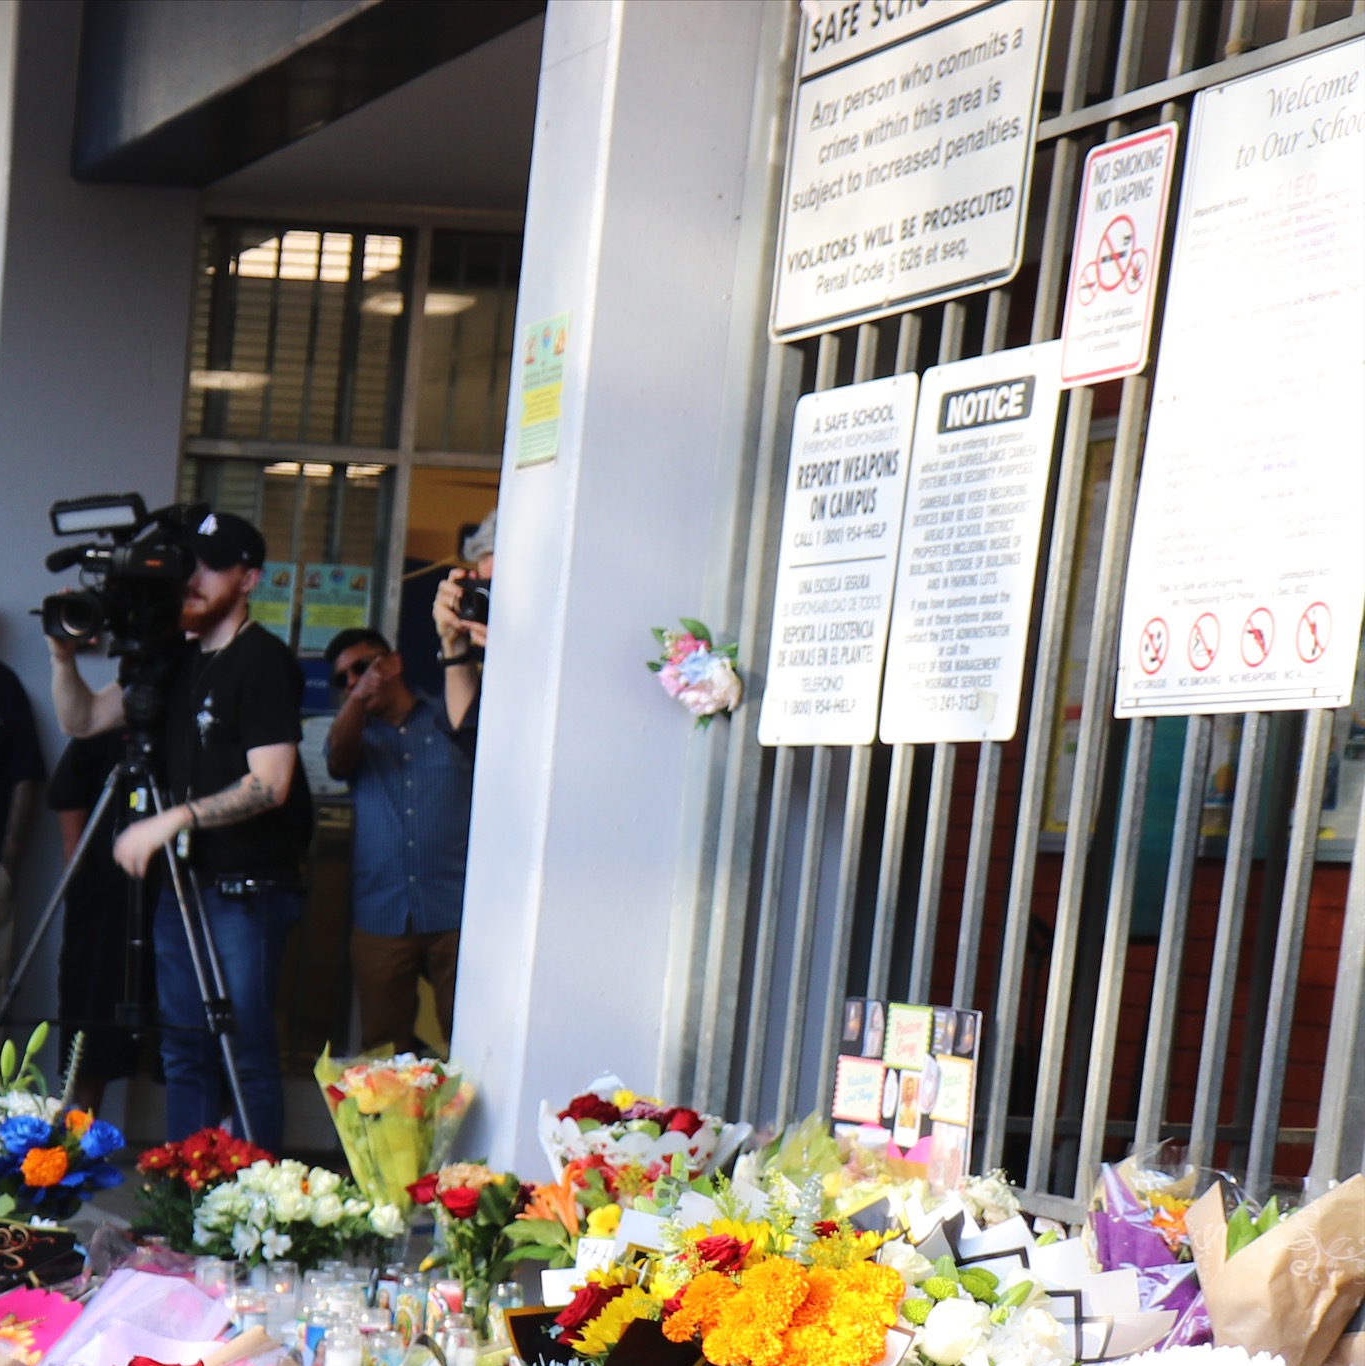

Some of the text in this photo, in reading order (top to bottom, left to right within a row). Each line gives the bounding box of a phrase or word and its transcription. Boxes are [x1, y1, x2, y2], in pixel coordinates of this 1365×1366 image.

[809, 2, 860, 52] SAFE
[809, 26, 1024, 127] Any person who commits a
[1267, 70, 1359, 118] Welcome
[818, 75, 1002, 165] crime within this area is
[1236, 144, 1256, 169] to
[1262, 131, 1304, 162] Our
[791, 117, 1024, 213] subject to increased penalties.
[1092, 146, 1163, 185] NO SMOKING
[1095, 177, 1154, 211] NO VAPING
[786, 185, 1015, 274] VIOLATORS WILL BE PROSECUTED
[815, 269, 848, 295] Penal
[852, 258, 884, 285] Code
[924, 242, 938, 265] et
[947, 383, 1025, 428] NOTICE
[812, 403, 894, 434] A SAFE SCHOOL
[950, 443, 960, 453] are
[962, 437, 989, 451] entering
[796, 448, 899, 490] REPORT WEAPONS
[957, 448, 1006, 467] SURVEILLANCE
[918, 474, 947, 490] SYSTEMS
[949, 471, 962, 484] FOR
[964, 467, 995, 483] SECURITY
[811, 486, 877, 522] ON CAMPUS
[920, 484, 1028, 509] CAMERAS AND VIDEO RECORDING
[913, 512, 939, 527] DEVICES
[940, 510, 955, 522] MAY
[956, 508, 965, 521] BE
[966, 506, 984, 519] USED
[794, 531, 813, 547] CALL
[816, 530, 820, 545] 1
[924, 519, 1015, 541] AREAS OF SCHOOL DISTRICT
[798, 573, 870, 595] UNA ESCUELA SEGURA
[927, 573, 978, 590] AND IN PARKING
[917, 600, 927, 612] you
[929, 599, 944, 609] have
[946, 595, 977, 608] questions
[979, 593, 997, 605] about
[999, 592, 1011, 603] the
[914, 610, 1003, 627] use of these systems please
[783, 620, 874, 644] REPORTA LA EXISTENCIA
[929, 631, 939, 641] the
[940, 629, 955, 641] SITE
[956, 624, 1010, 640] ADMINISTRATOR
[777, 650, 787, 668] DE
[789, 647, 816, 667] ARMAS
[817, 647, 828, 666] EN
[830, 646, 839, 665] EL
[946, 645, 957, 655] call
[959, 643, 970, 654] the
[929, 656, 1001, 672] OF RISK MANAGEMENT
[925, 675, 992, 688] INSURANCE SERVICES
